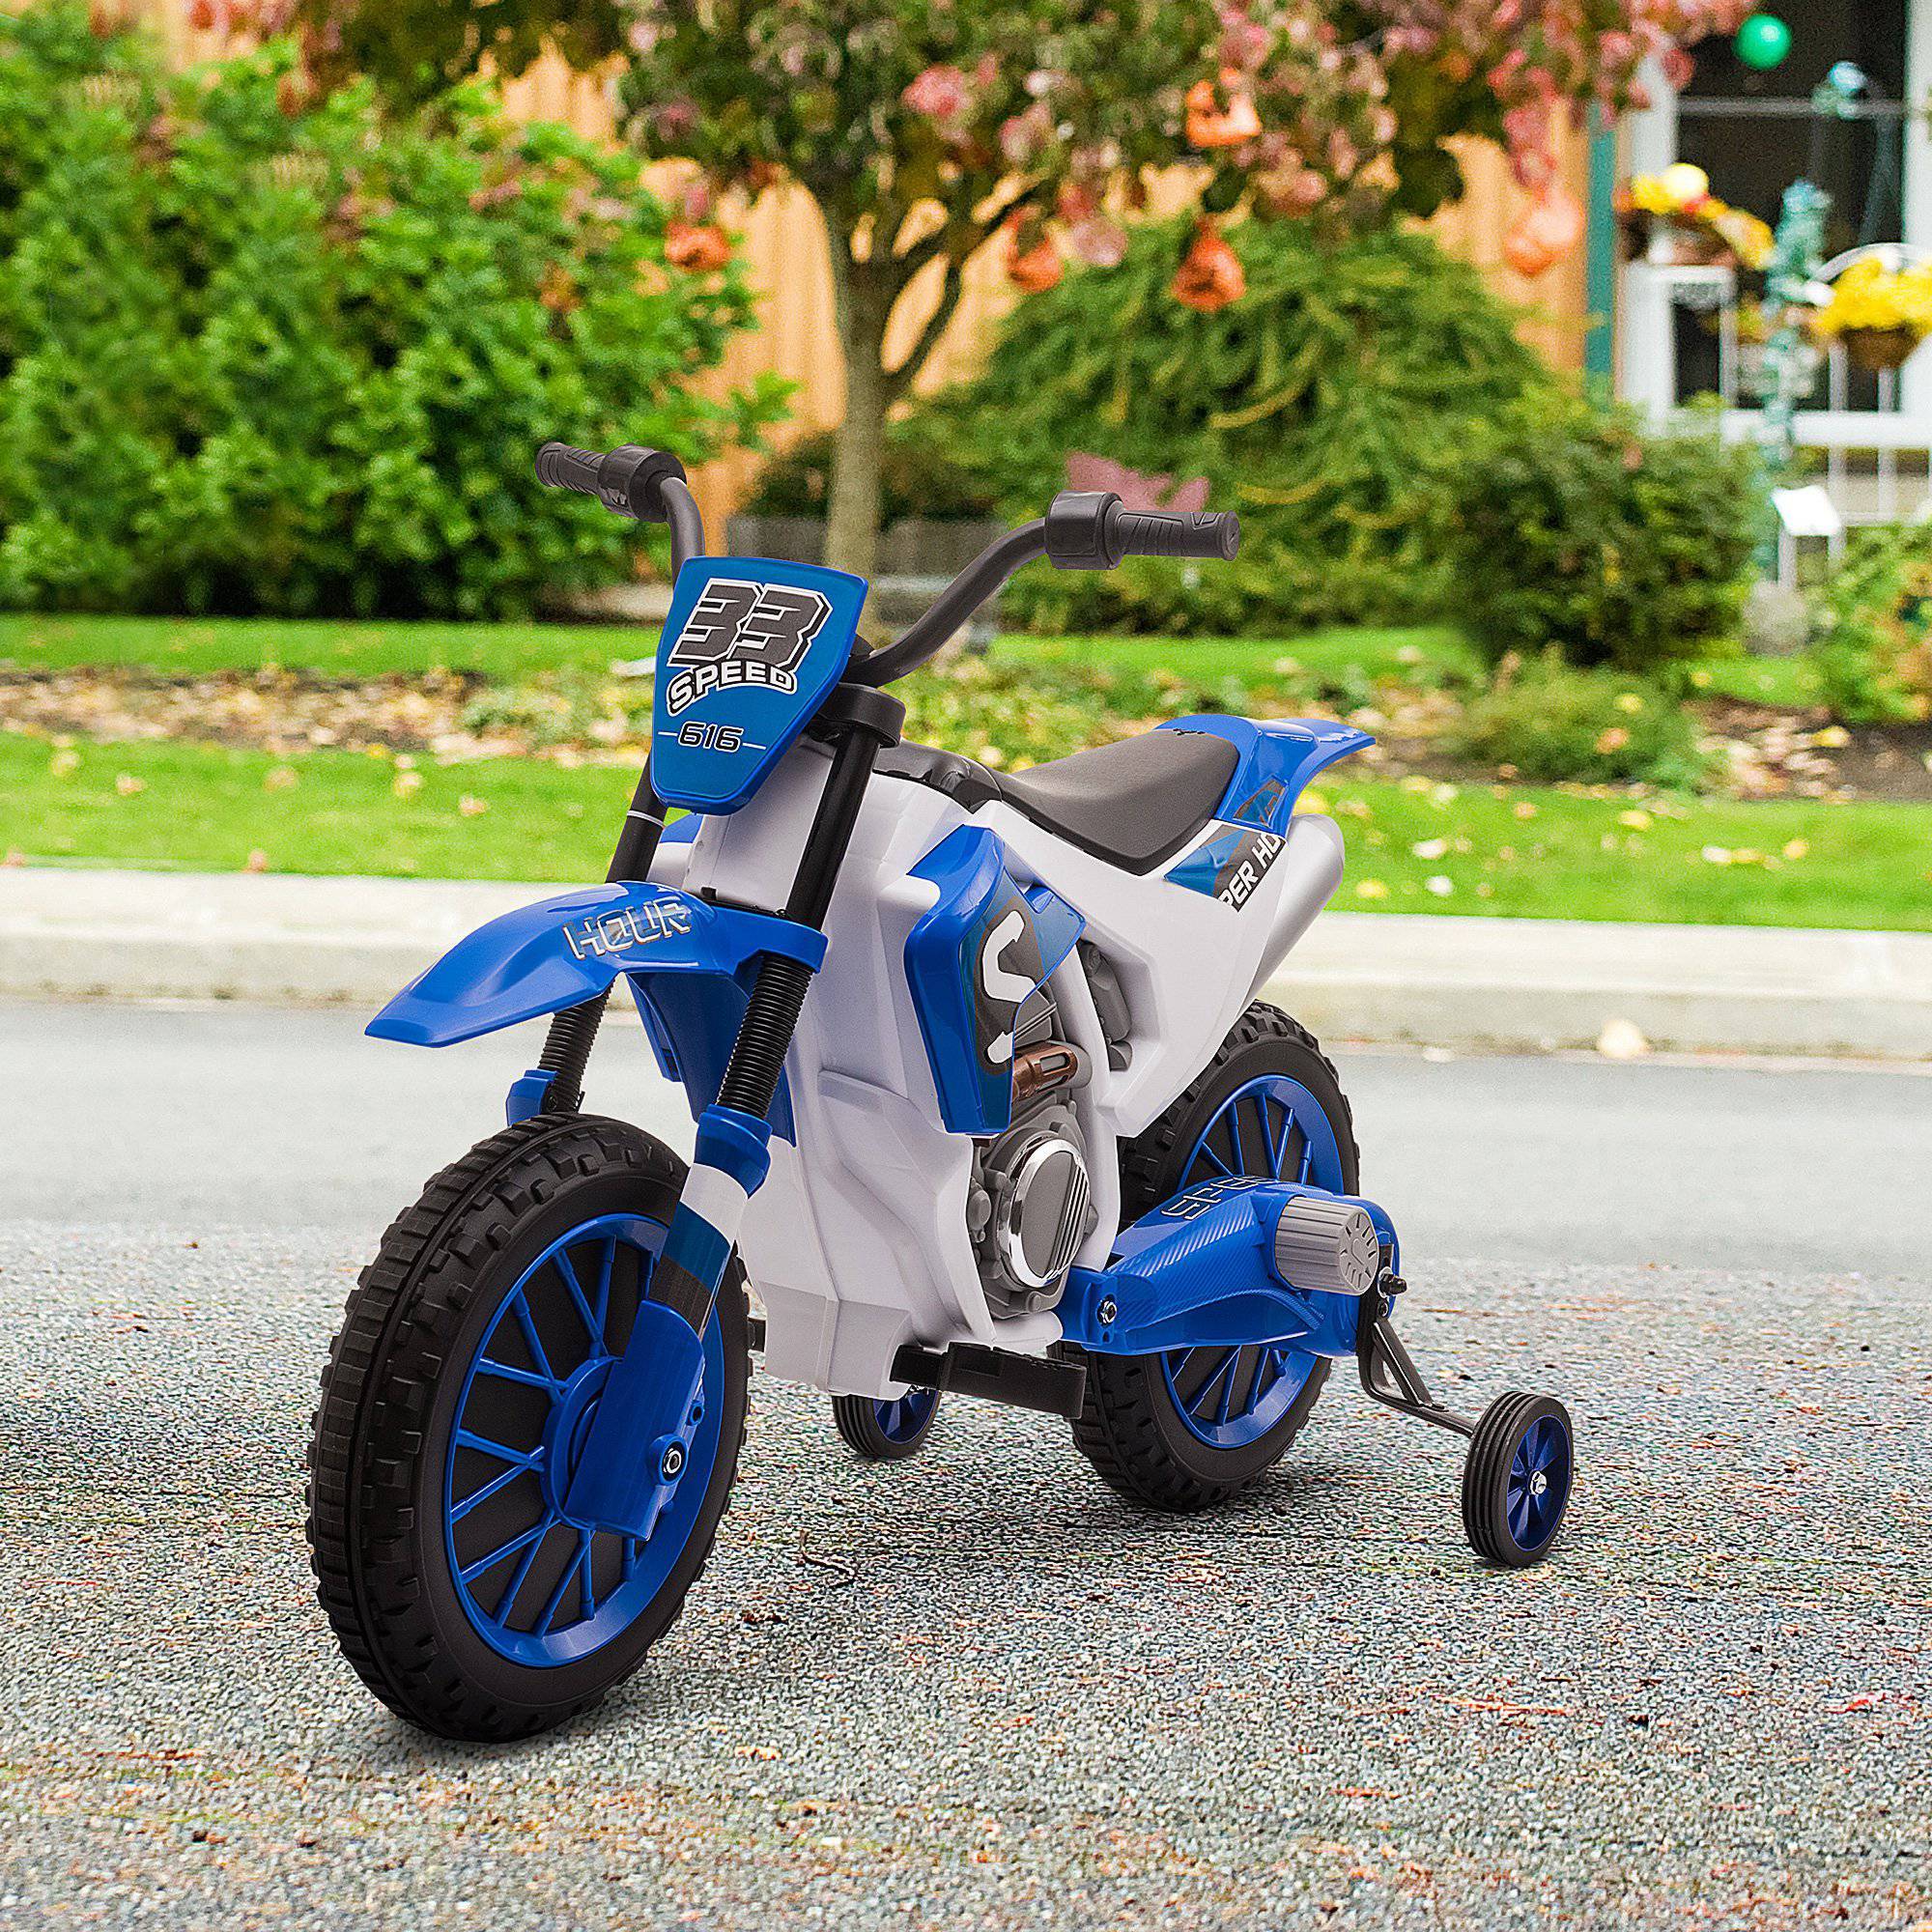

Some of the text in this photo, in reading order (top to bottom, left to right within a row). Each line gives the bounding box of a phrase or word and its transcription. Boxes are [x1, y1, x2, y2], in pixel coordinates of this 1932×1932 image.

[668, 578, 834, 672] 33
[667, 660, 797, 717] SPEED
[678, 721, 744, 753] 616
[562, 895, 692, 960] HOUR
